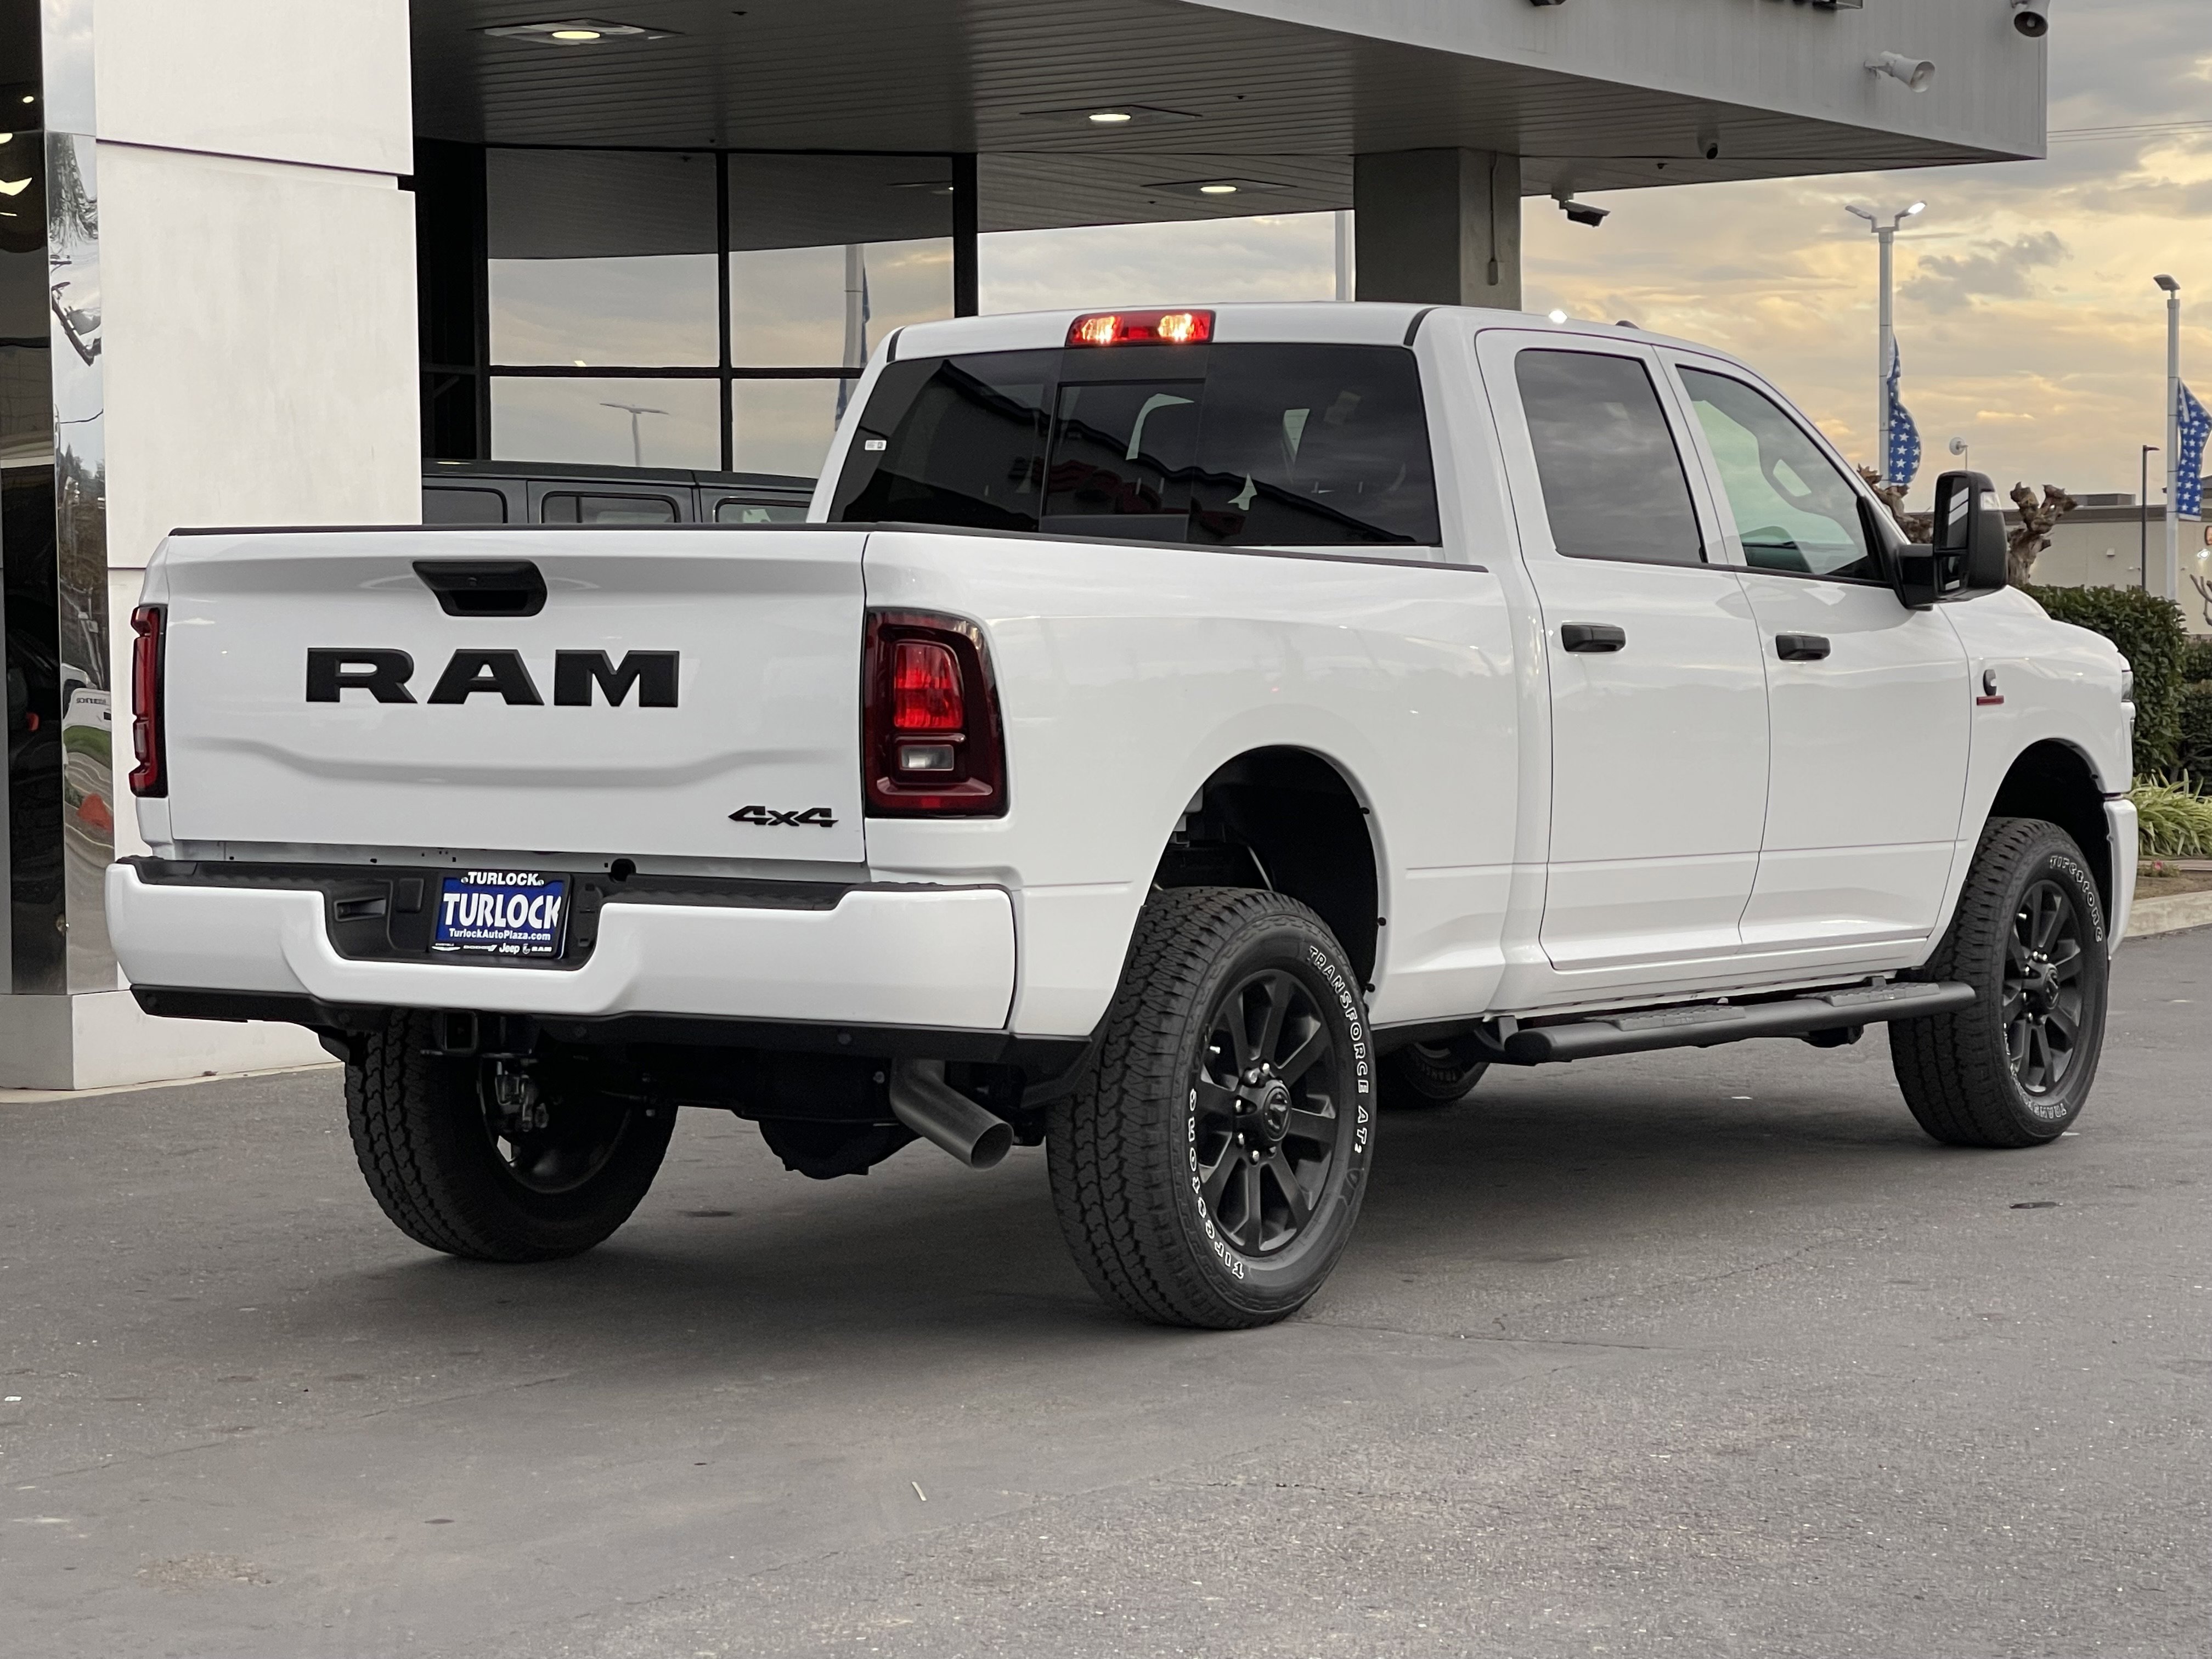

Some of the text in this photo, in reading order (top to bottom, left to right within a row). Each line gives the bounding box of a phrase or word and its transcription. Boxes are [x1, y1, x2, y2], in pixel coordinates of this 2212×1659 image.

[306, 647, 680, 708] RAM
[728, 805, 839, 827] 4x4
[467, 871, 539, 886] TURLOCK
[443, 893, 562, 929] TURLOCK
[449, 928, 551, 941] TurlockAutoPlaza.com
[499, 943, 520, 954] Jeep
[1309, 945, 1369, 1093] TRANSFORCE
